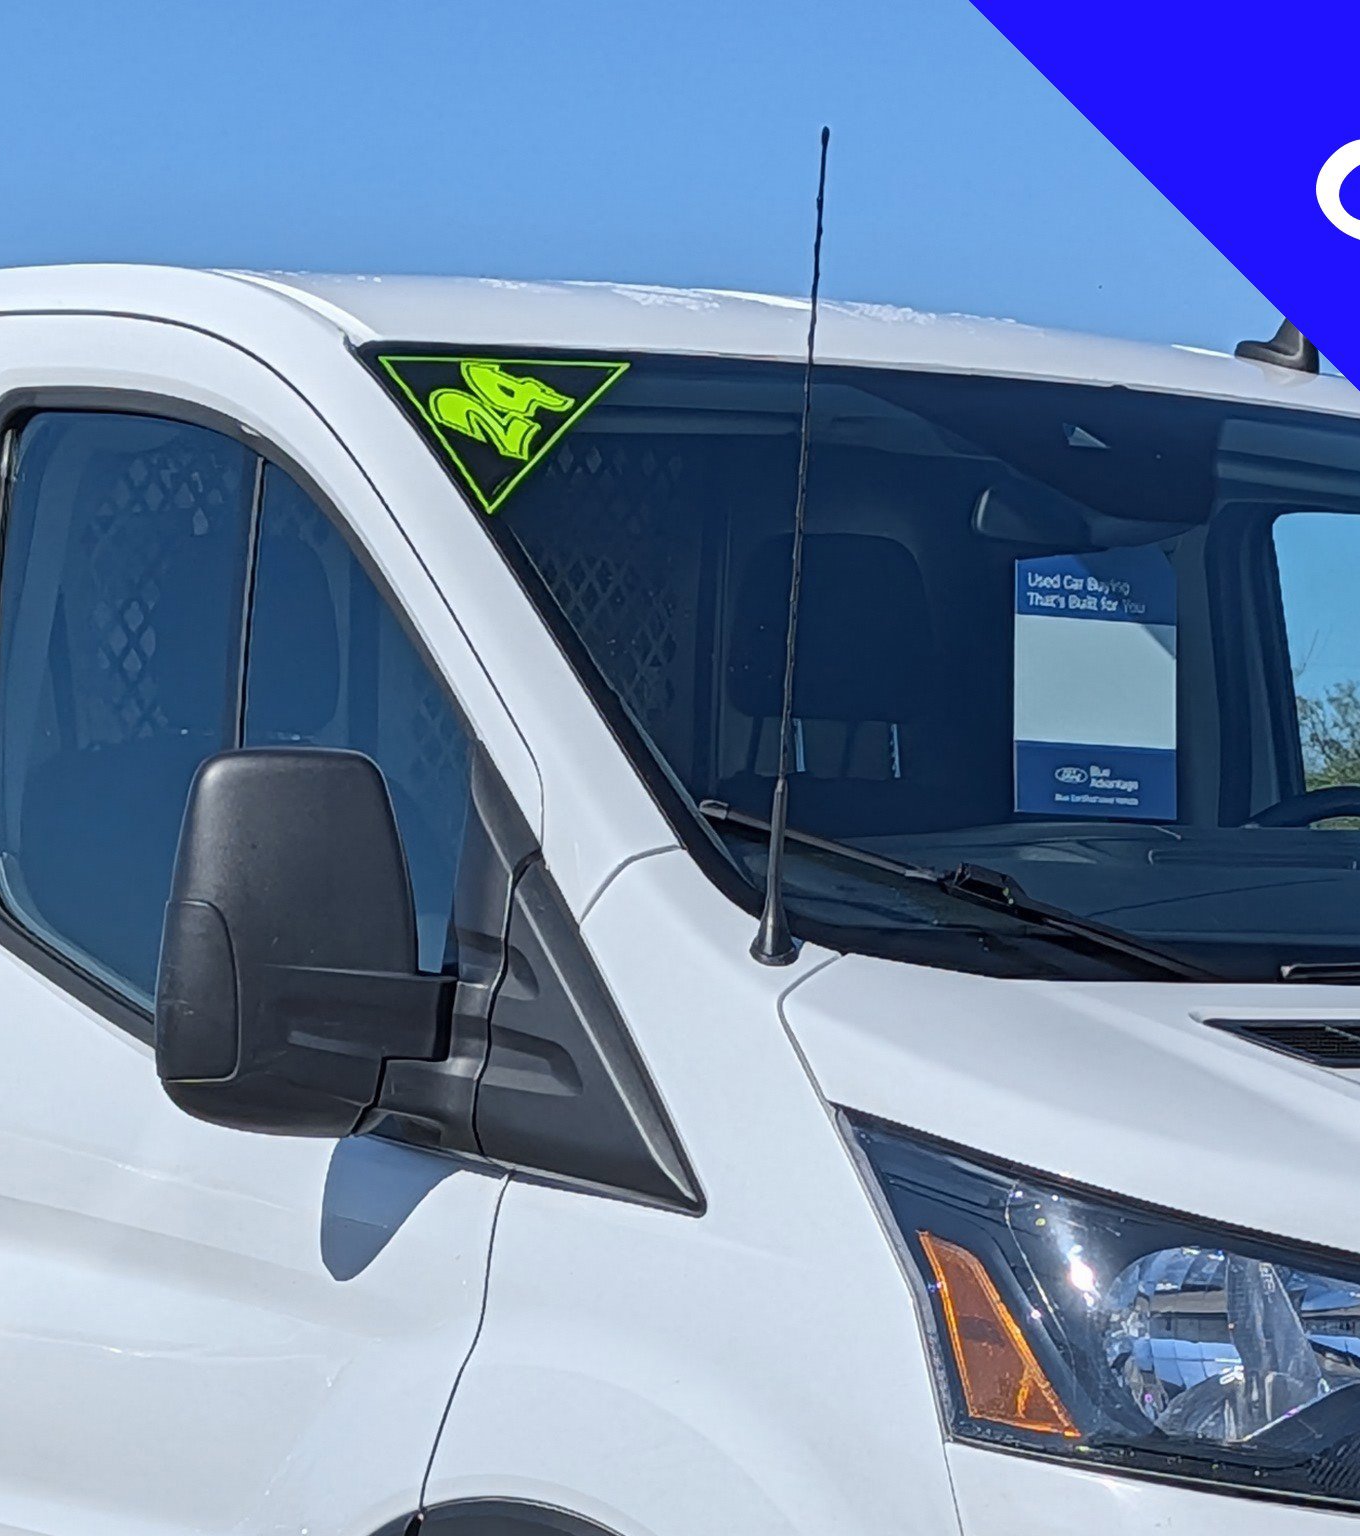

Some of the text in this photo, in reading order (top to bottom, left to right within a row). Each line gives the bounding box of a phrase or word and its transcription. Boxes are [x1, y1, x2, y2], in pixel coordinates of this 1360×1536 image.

[1027, 572, 1061, 589] Used
[1063, 574, 1084, 590] Car
[1026, 591, 1066, 609] That's
[1100, 596, 1118, 612] for
[1122, 598, 1146, 614] You
